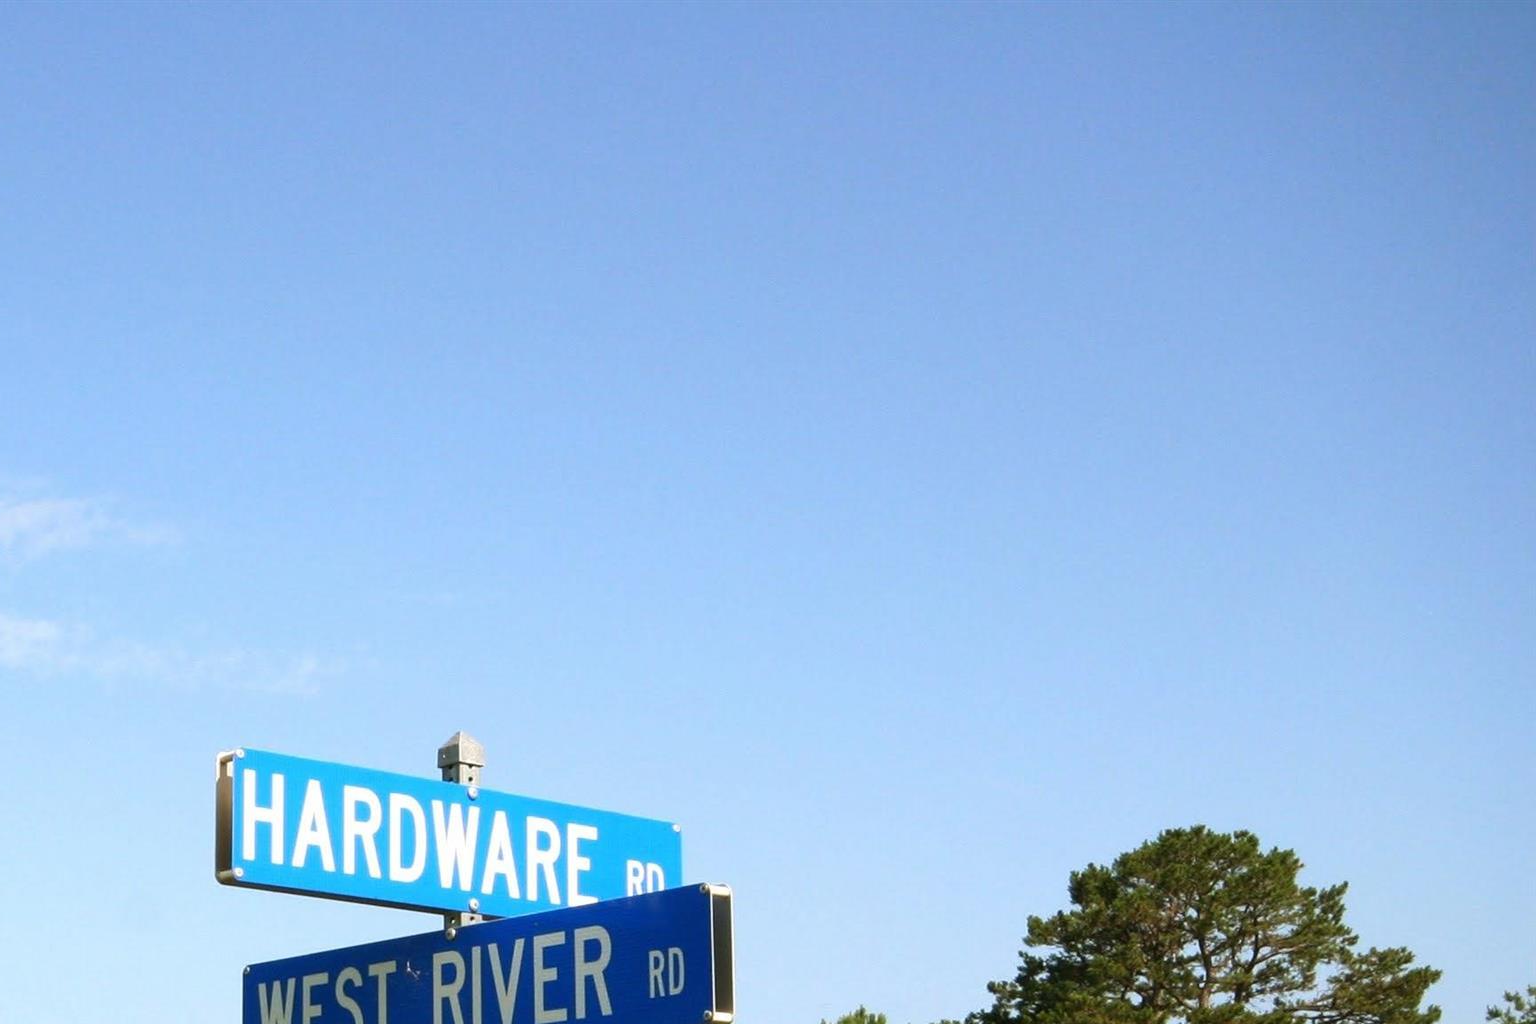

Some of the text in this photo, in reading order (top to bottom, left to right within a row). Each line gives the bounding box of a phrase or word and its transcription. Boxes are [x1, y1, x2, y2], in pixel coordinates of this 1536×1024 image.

[242, 768, 665, 906] HARDWARE RD
[649, 947, 685, 998] RD
